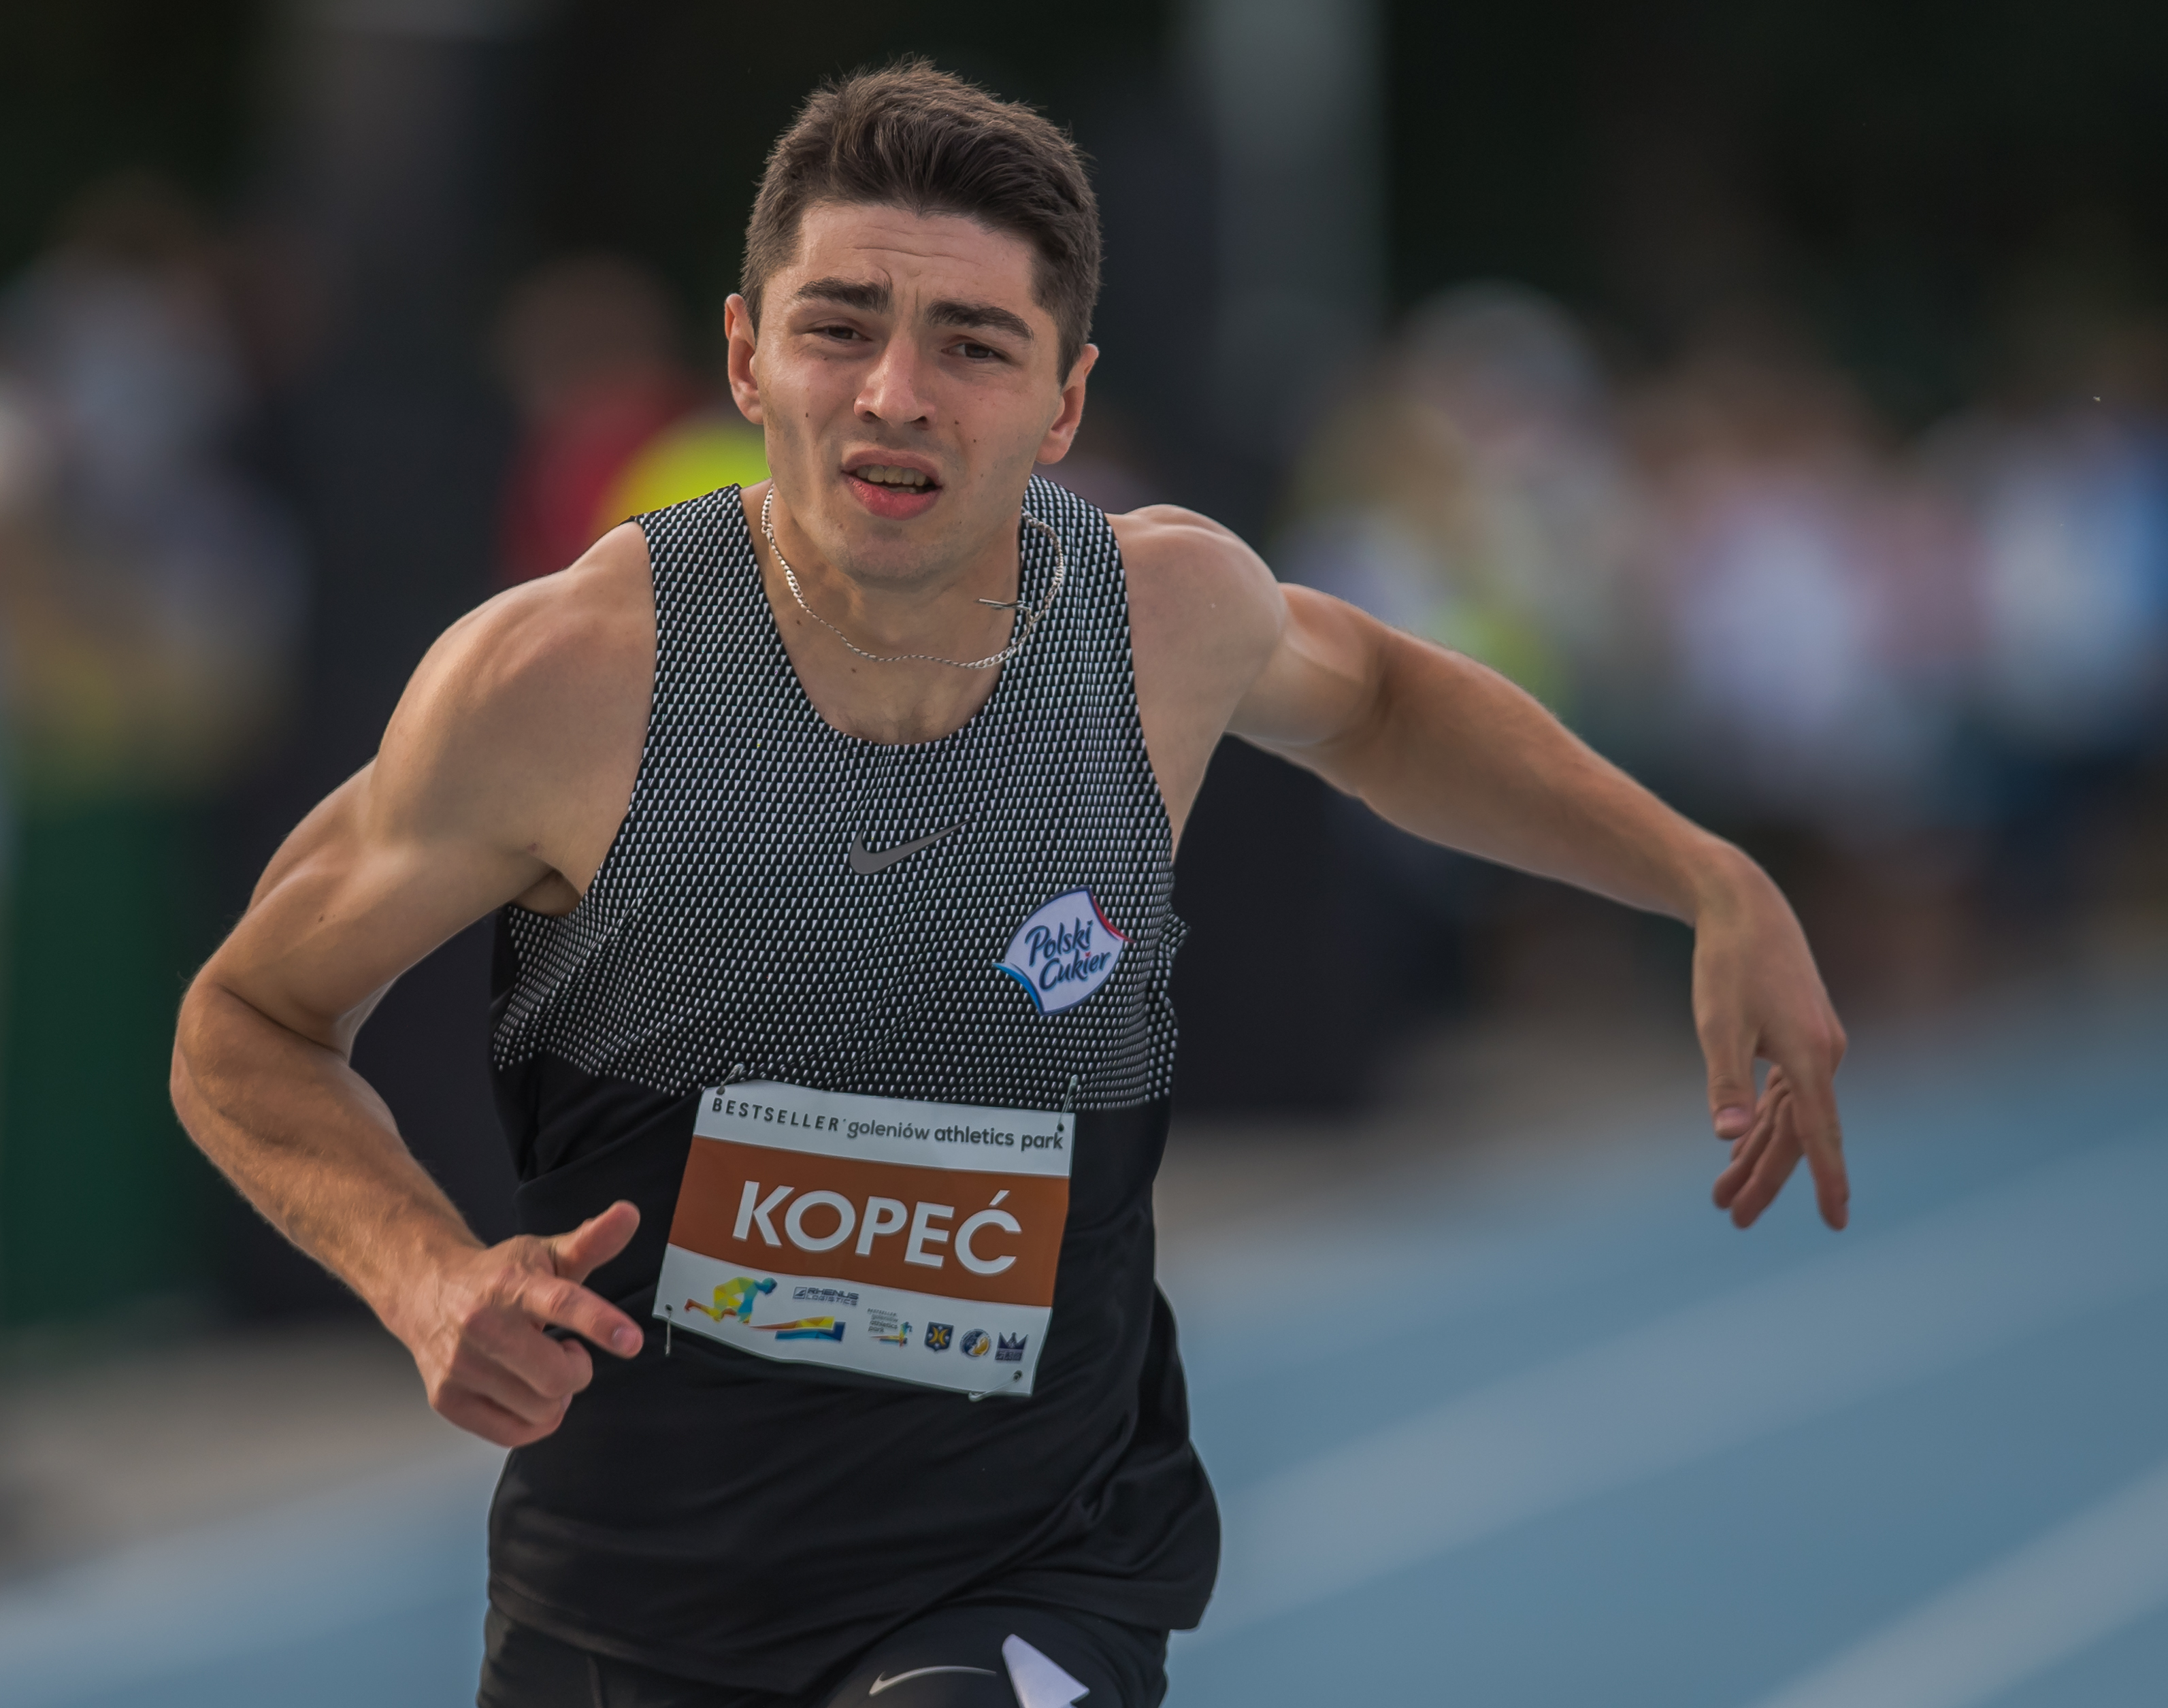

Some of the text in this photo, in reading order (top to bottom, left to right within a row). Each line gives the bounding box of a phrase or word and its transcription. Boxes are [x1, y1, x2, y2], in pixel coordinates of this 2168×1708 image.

[1025, 917, 1093, 966] Polski
[1039, 949, 1111, 991] Cukier
[712, 1097, 1064, 1151] BESTSELLER goleniów athletics park
[732, 1181, 1022, 1275] KOPEĆ
[806, 1294, 857, 1305] LOGISTICS
[808, 1287, 859, 1300] RHENUS
